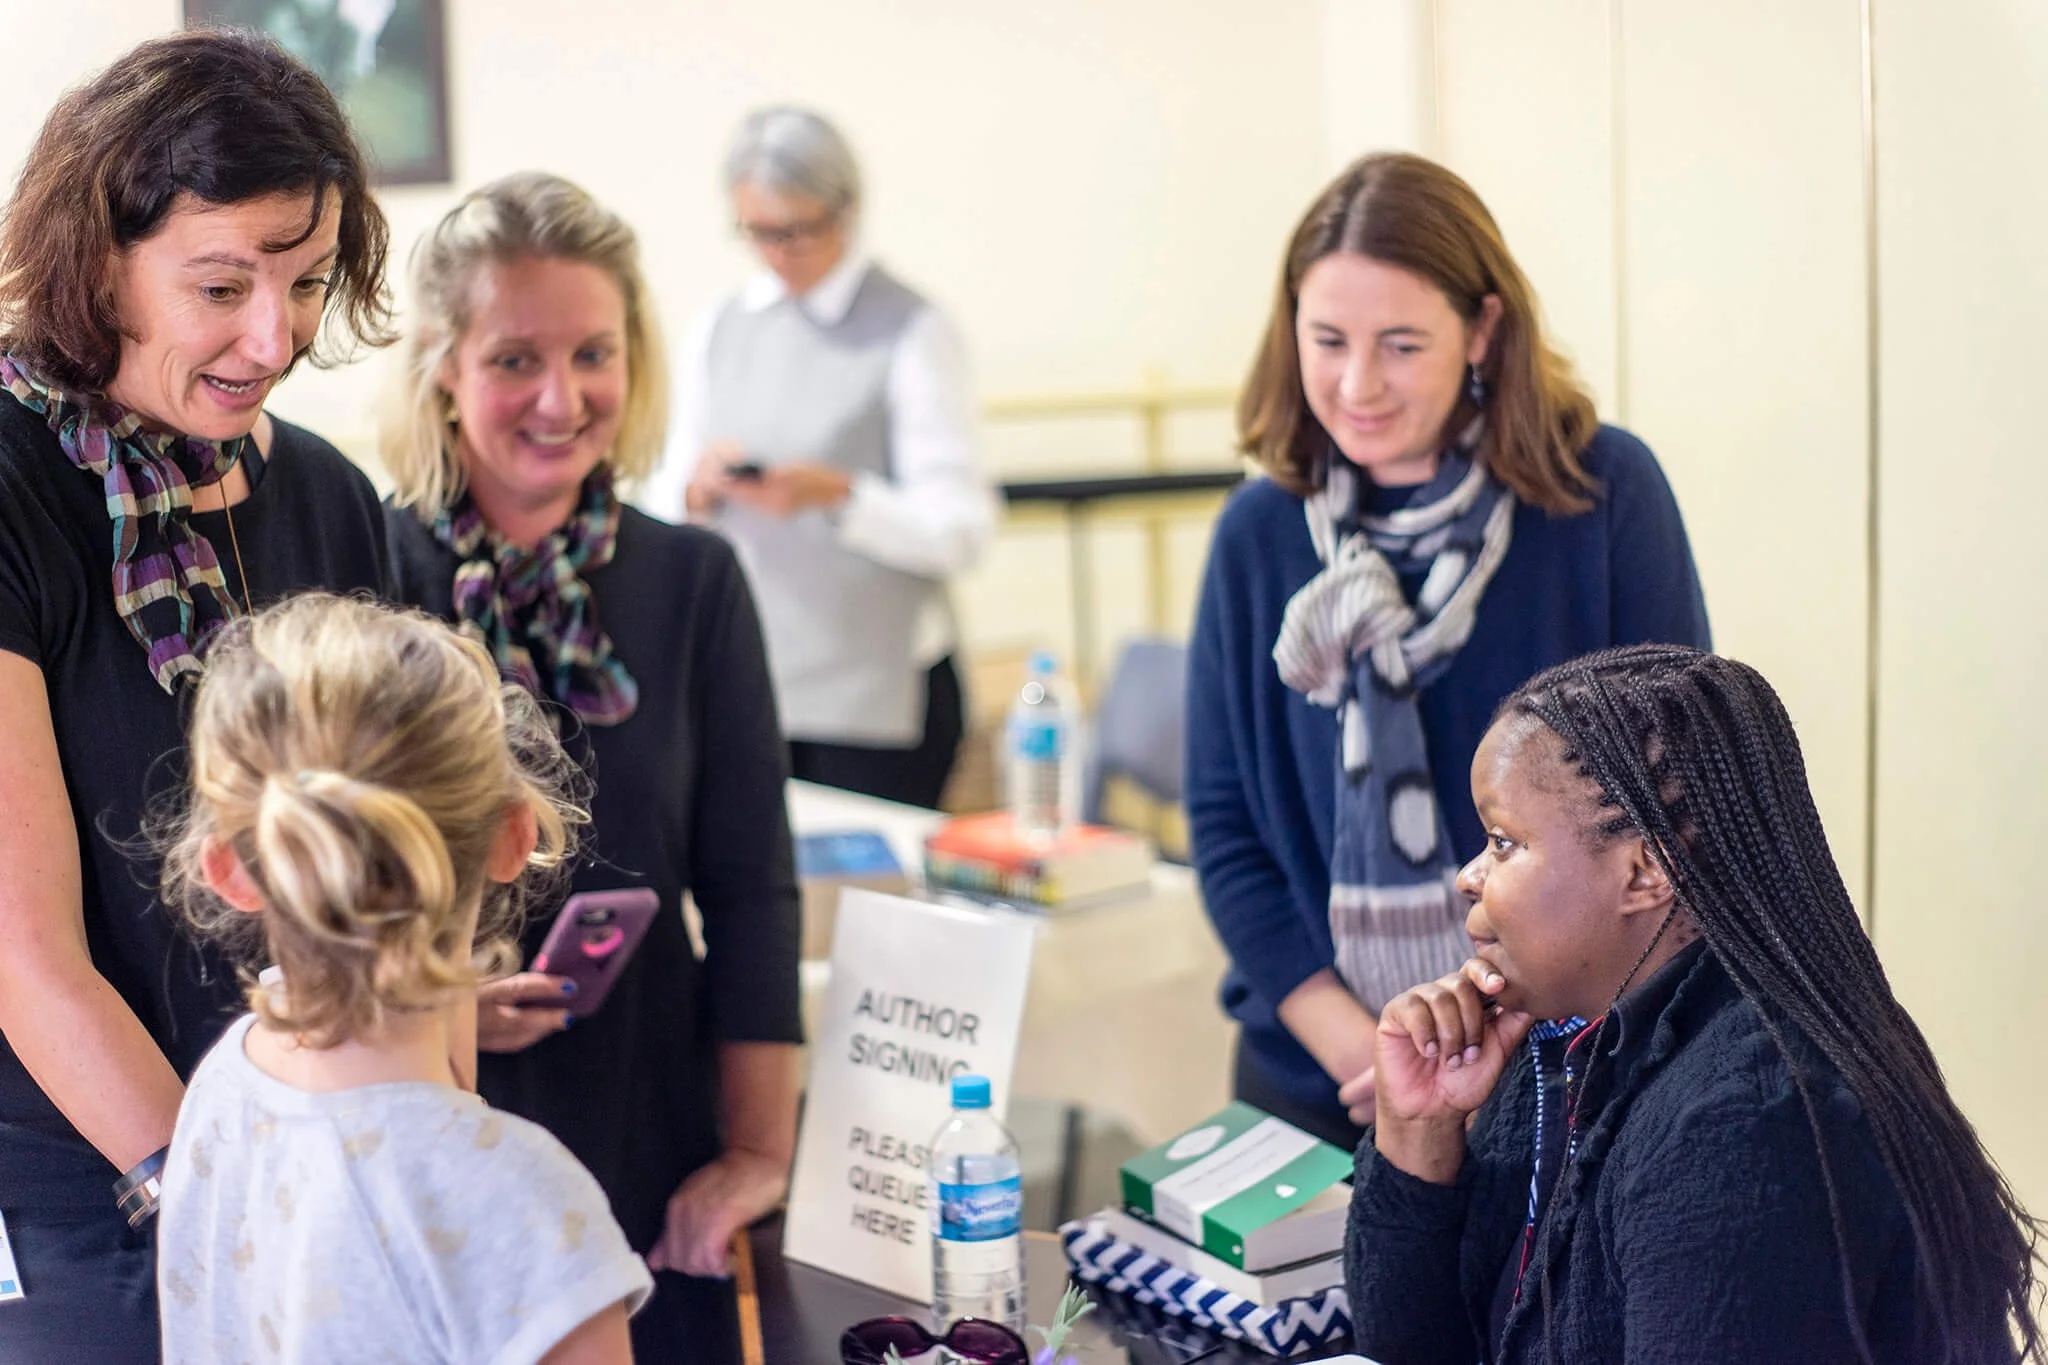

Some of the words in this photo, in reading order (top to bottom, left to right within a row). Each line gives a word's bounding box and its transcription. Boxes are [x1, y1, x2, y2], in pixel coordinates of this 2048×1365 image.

[854, 989, 979, 1045] AUTHOR
[848, 1126, 932, 1169] PLEAS
[848, 1165, 928, 1210] QUEUE
[851, 1204, 916, 1245] HERE
